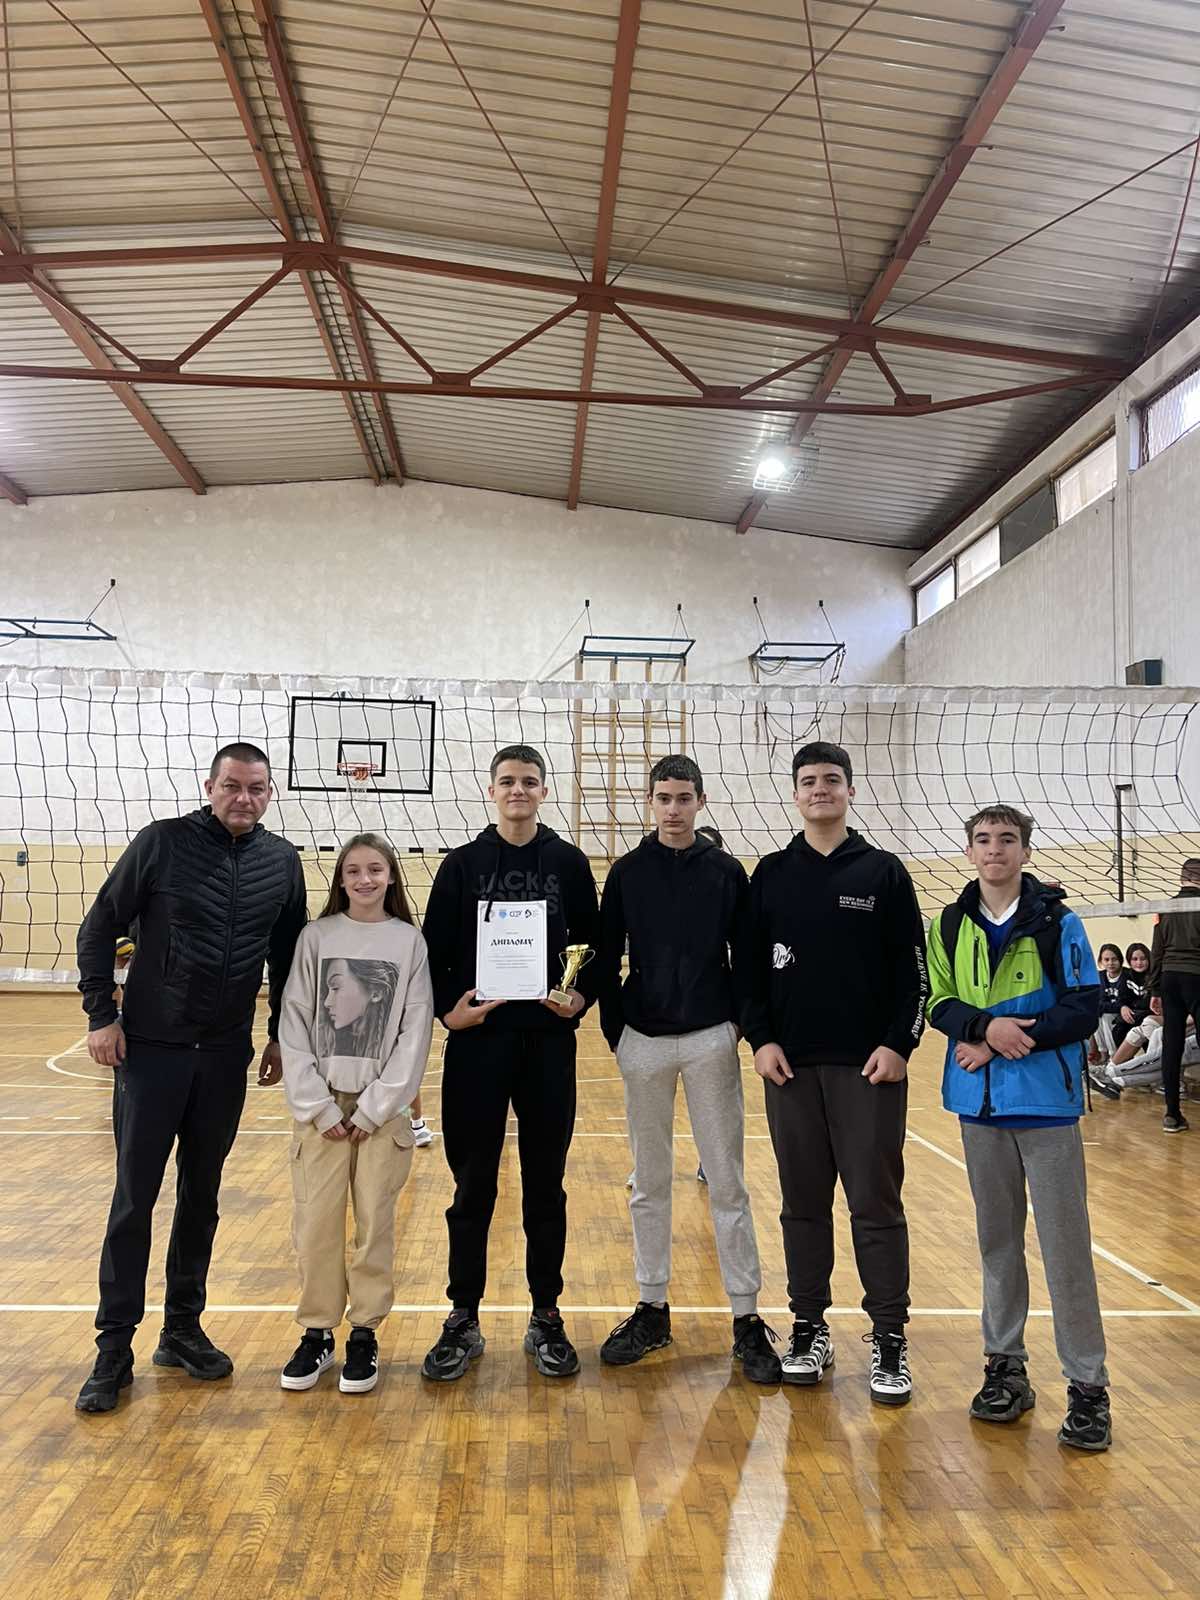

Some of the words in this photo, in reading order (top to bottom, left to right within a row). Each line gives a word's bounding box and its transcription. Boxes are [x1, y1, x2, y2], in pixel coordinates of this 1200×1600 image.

[543, 873, 560, 895] &
[914, 945, 928, 982] BELIEVE
[911, 996, 926, 1039] YOURSELF
